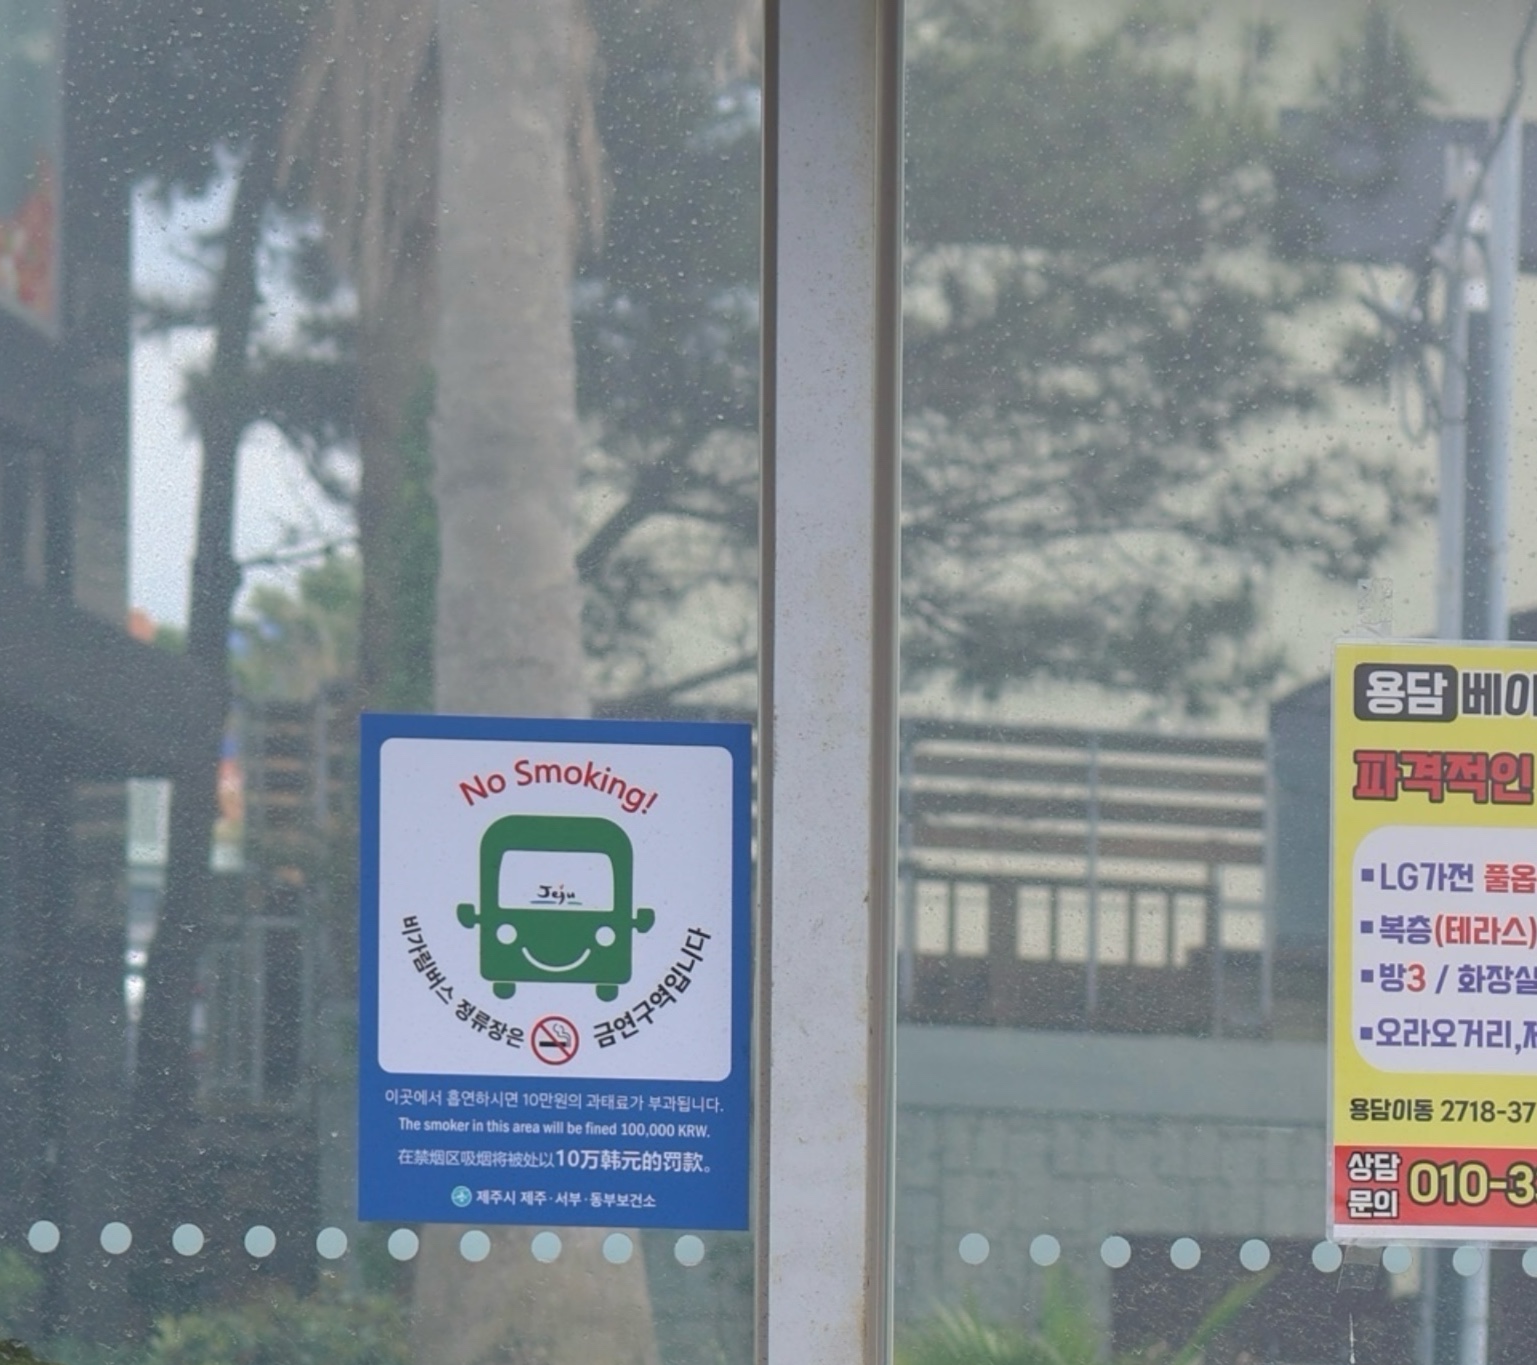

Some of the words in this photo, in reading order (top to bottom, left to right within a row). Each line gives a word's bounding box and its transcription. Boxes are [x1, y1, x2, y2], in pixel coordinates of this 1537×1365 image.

[1365, 670, 1449, 716] 용담
[458, 773, 506, 807] No
[513, 759, 659, 815] Smoking!
[1351, 749, 1535, 805] 파격적인
[536, 883, 576, 905] Jeju
[1379, 861, 1475, 894] LG가전
[1483, 862, 1537, 895] 풀옵
[1378, 914, 1537, 950] 복층(테라스)
[401, 914, 454, 1005] 비가림버스
[454, 997, 526, 1049] 정류장은
[592, 927, 712, 1049] 금연구역입니다
[1378, 963, 1427, 995] 방3
[1457, 965, 1537, 996] 화장실
[384, 1088, 442, 1107] 이곳에서
[446, 1090, 519, 1108] 흡연하시면
[522, 1092, 582, 1111] 10만원의
[585, 1093, 645, 1112] 과태료가
[648, 1095, 725, 1114] 부과됩니다.
[1349, 1097, 1435, 1123] 용담이동
[1440, 1099, 1537, 1125] 2718-37
[398, 1117, 422, 1131] The
[423, 1118, 469, 1132] smoker
[472, 1119, 484, 1132] in
[486, 1119, 510, 1133] this
[512, 1123, 541, 1134] area
[543, 1121, 564, 1134] will
[566, 1121, 583, 1135] be
[585, 1121, 618, 1136] fined
[620, 1123, 675, 1140] 100,000
[677, 1125, 711, 1139] KRW.
[1347, 1151, 1401, 1182] 상담
[1406, 1159, 1537, 1207] 010-3
[475, 1188, 516, 1206] 제주시
[1347, 1188, 1400, 1219] 문의
